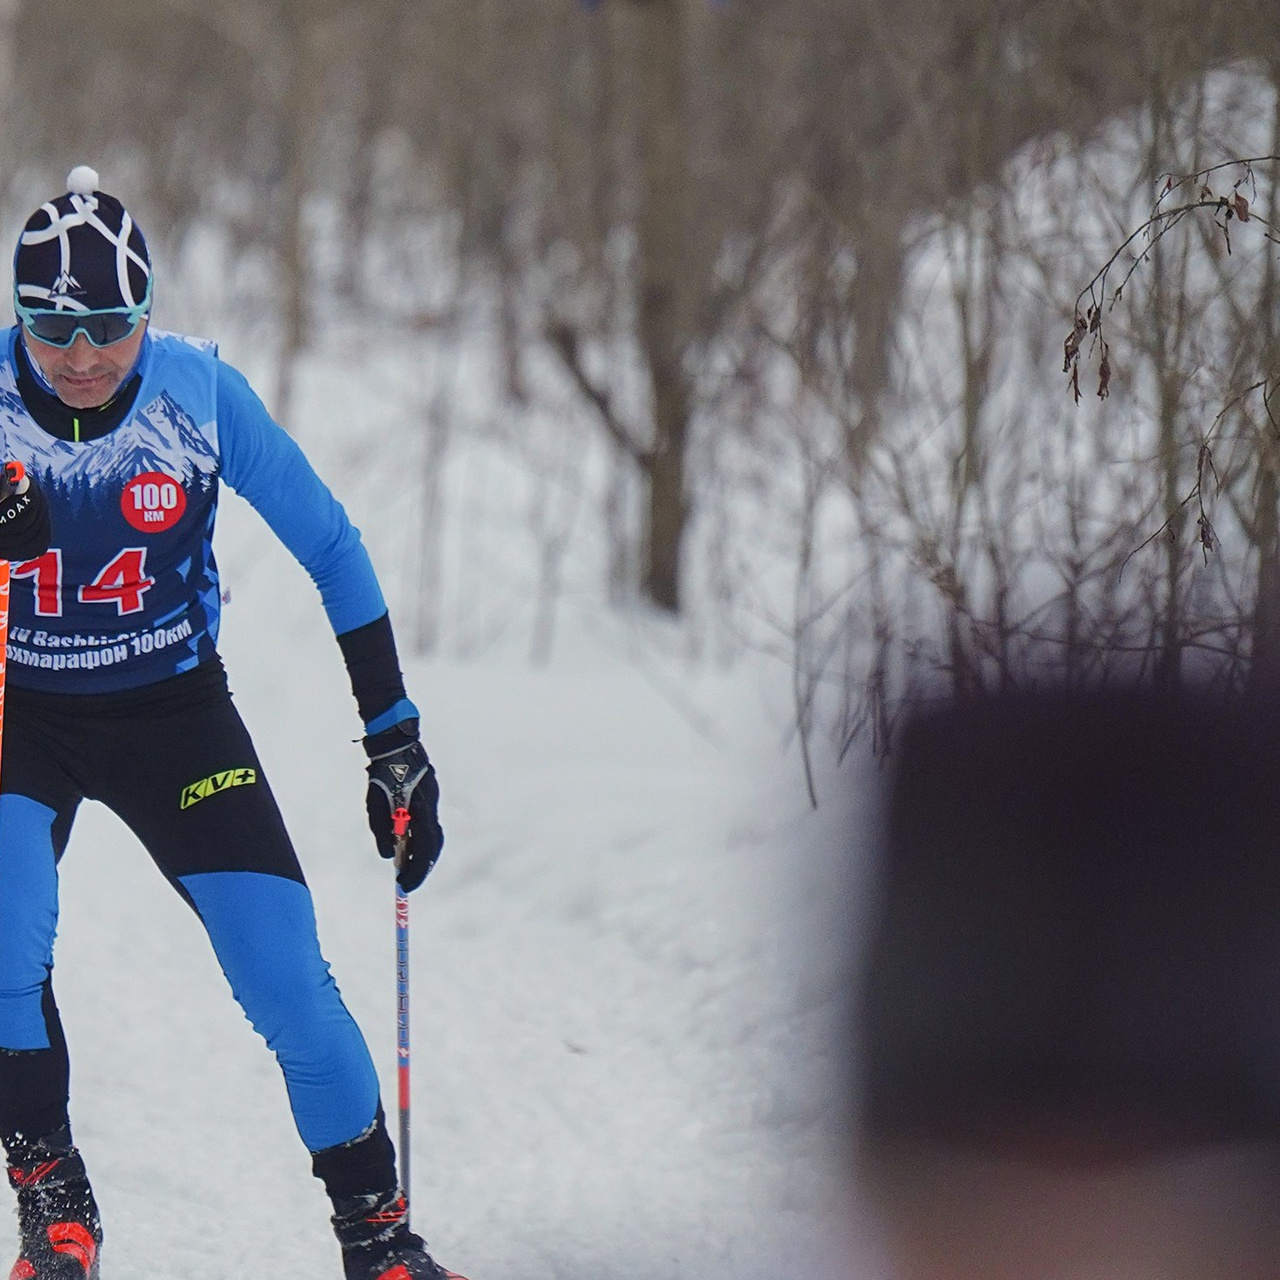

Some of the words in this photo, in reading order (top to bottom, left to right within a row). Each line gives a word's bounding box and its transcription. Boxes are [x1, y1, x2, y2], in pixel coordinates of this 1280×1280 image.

[129, 483, 178, 510] 100
[10, 547, 156, 617] 14
[181, 768, 256, 809] KV+
